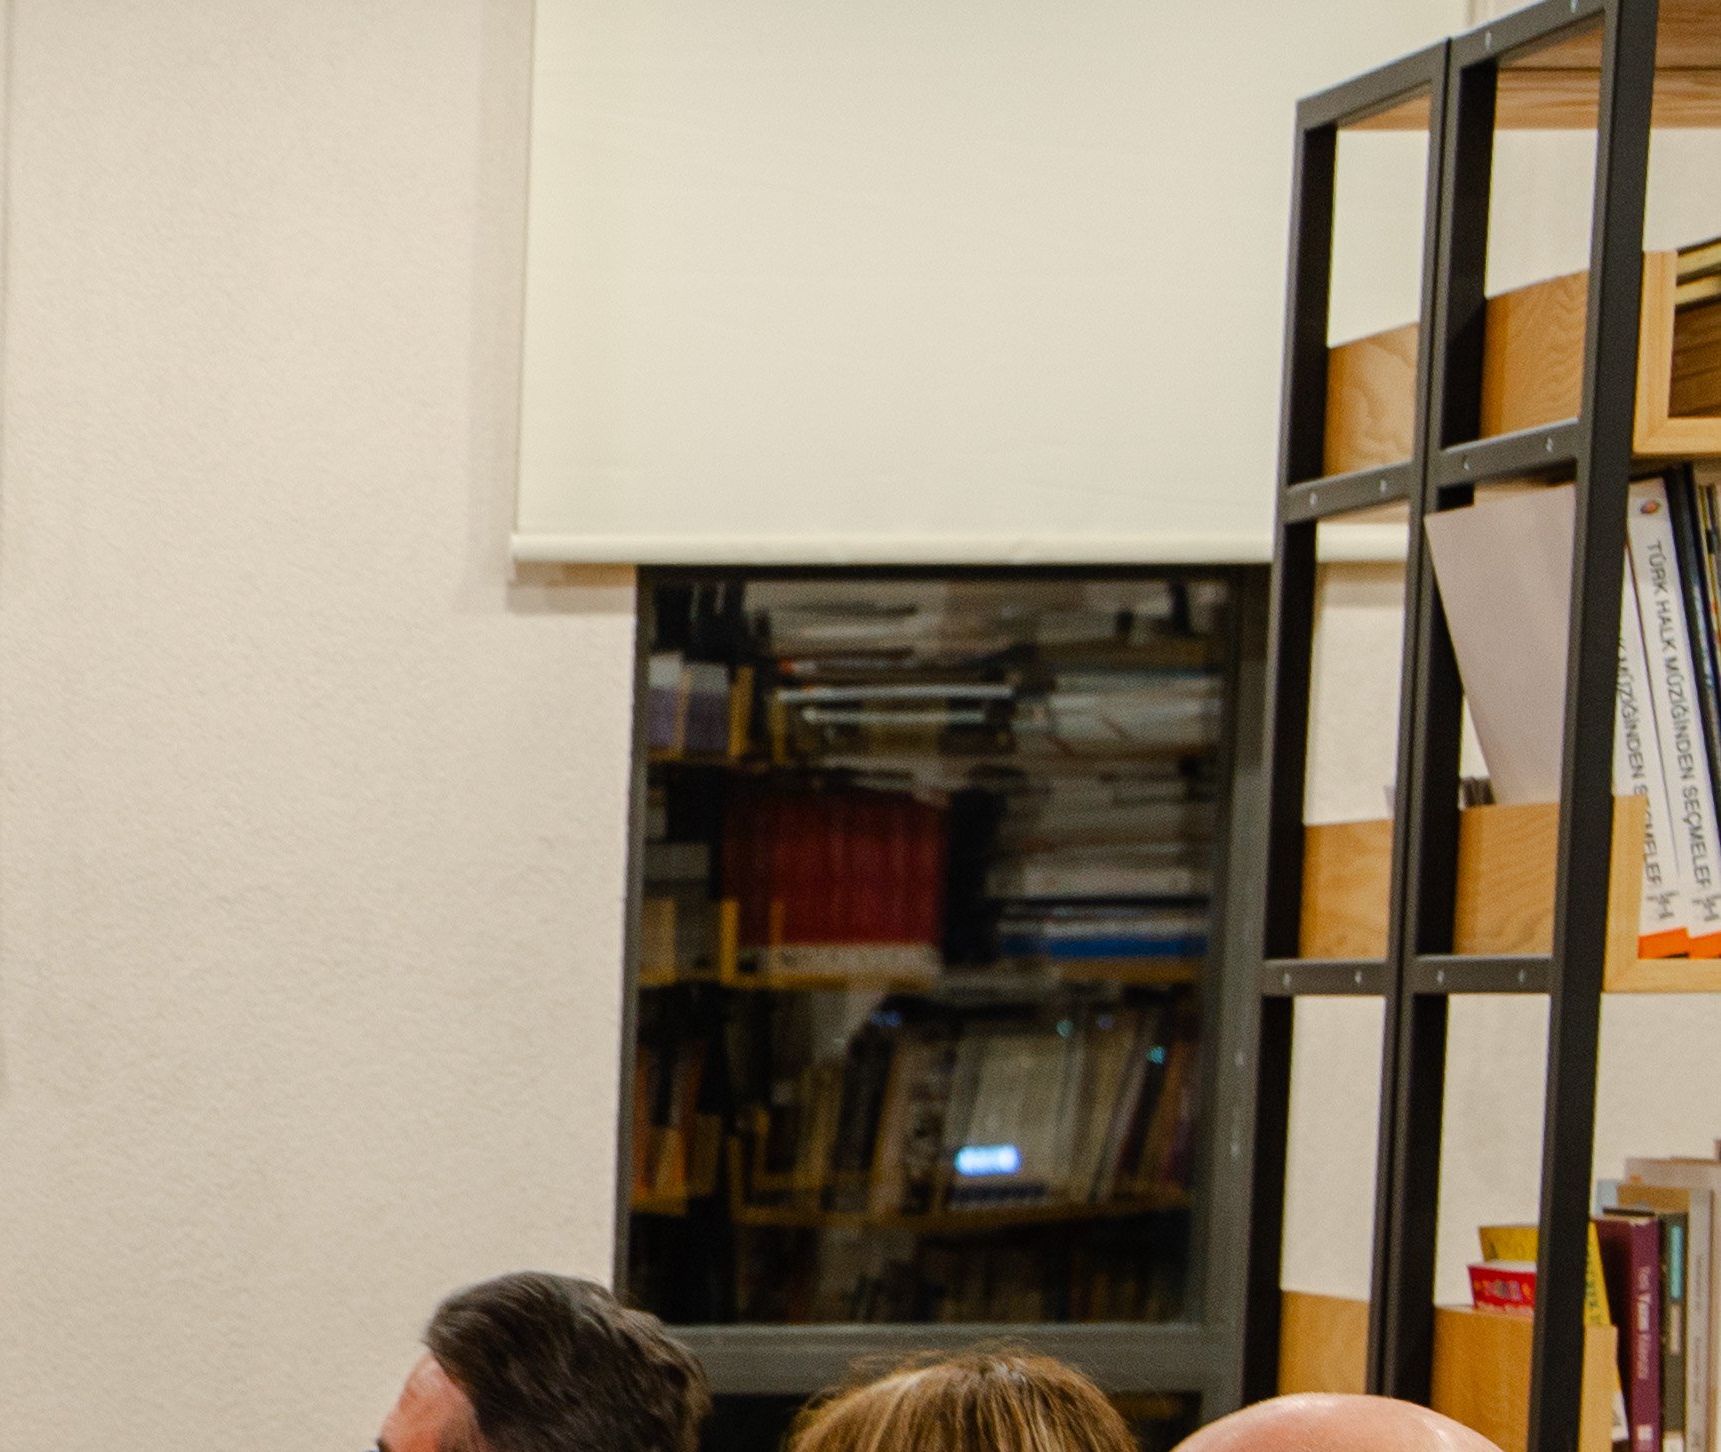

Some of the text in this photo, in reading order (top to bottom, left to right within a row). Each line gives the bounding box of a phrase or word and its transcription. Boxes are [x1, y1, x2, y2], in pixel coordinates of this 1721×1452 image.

[1646, 539, 1668, 593] TÜRK
[1657, 601, 1677, 651] HALK
[1664, 656, 1695, 780] MÜZİĞİNDEN
